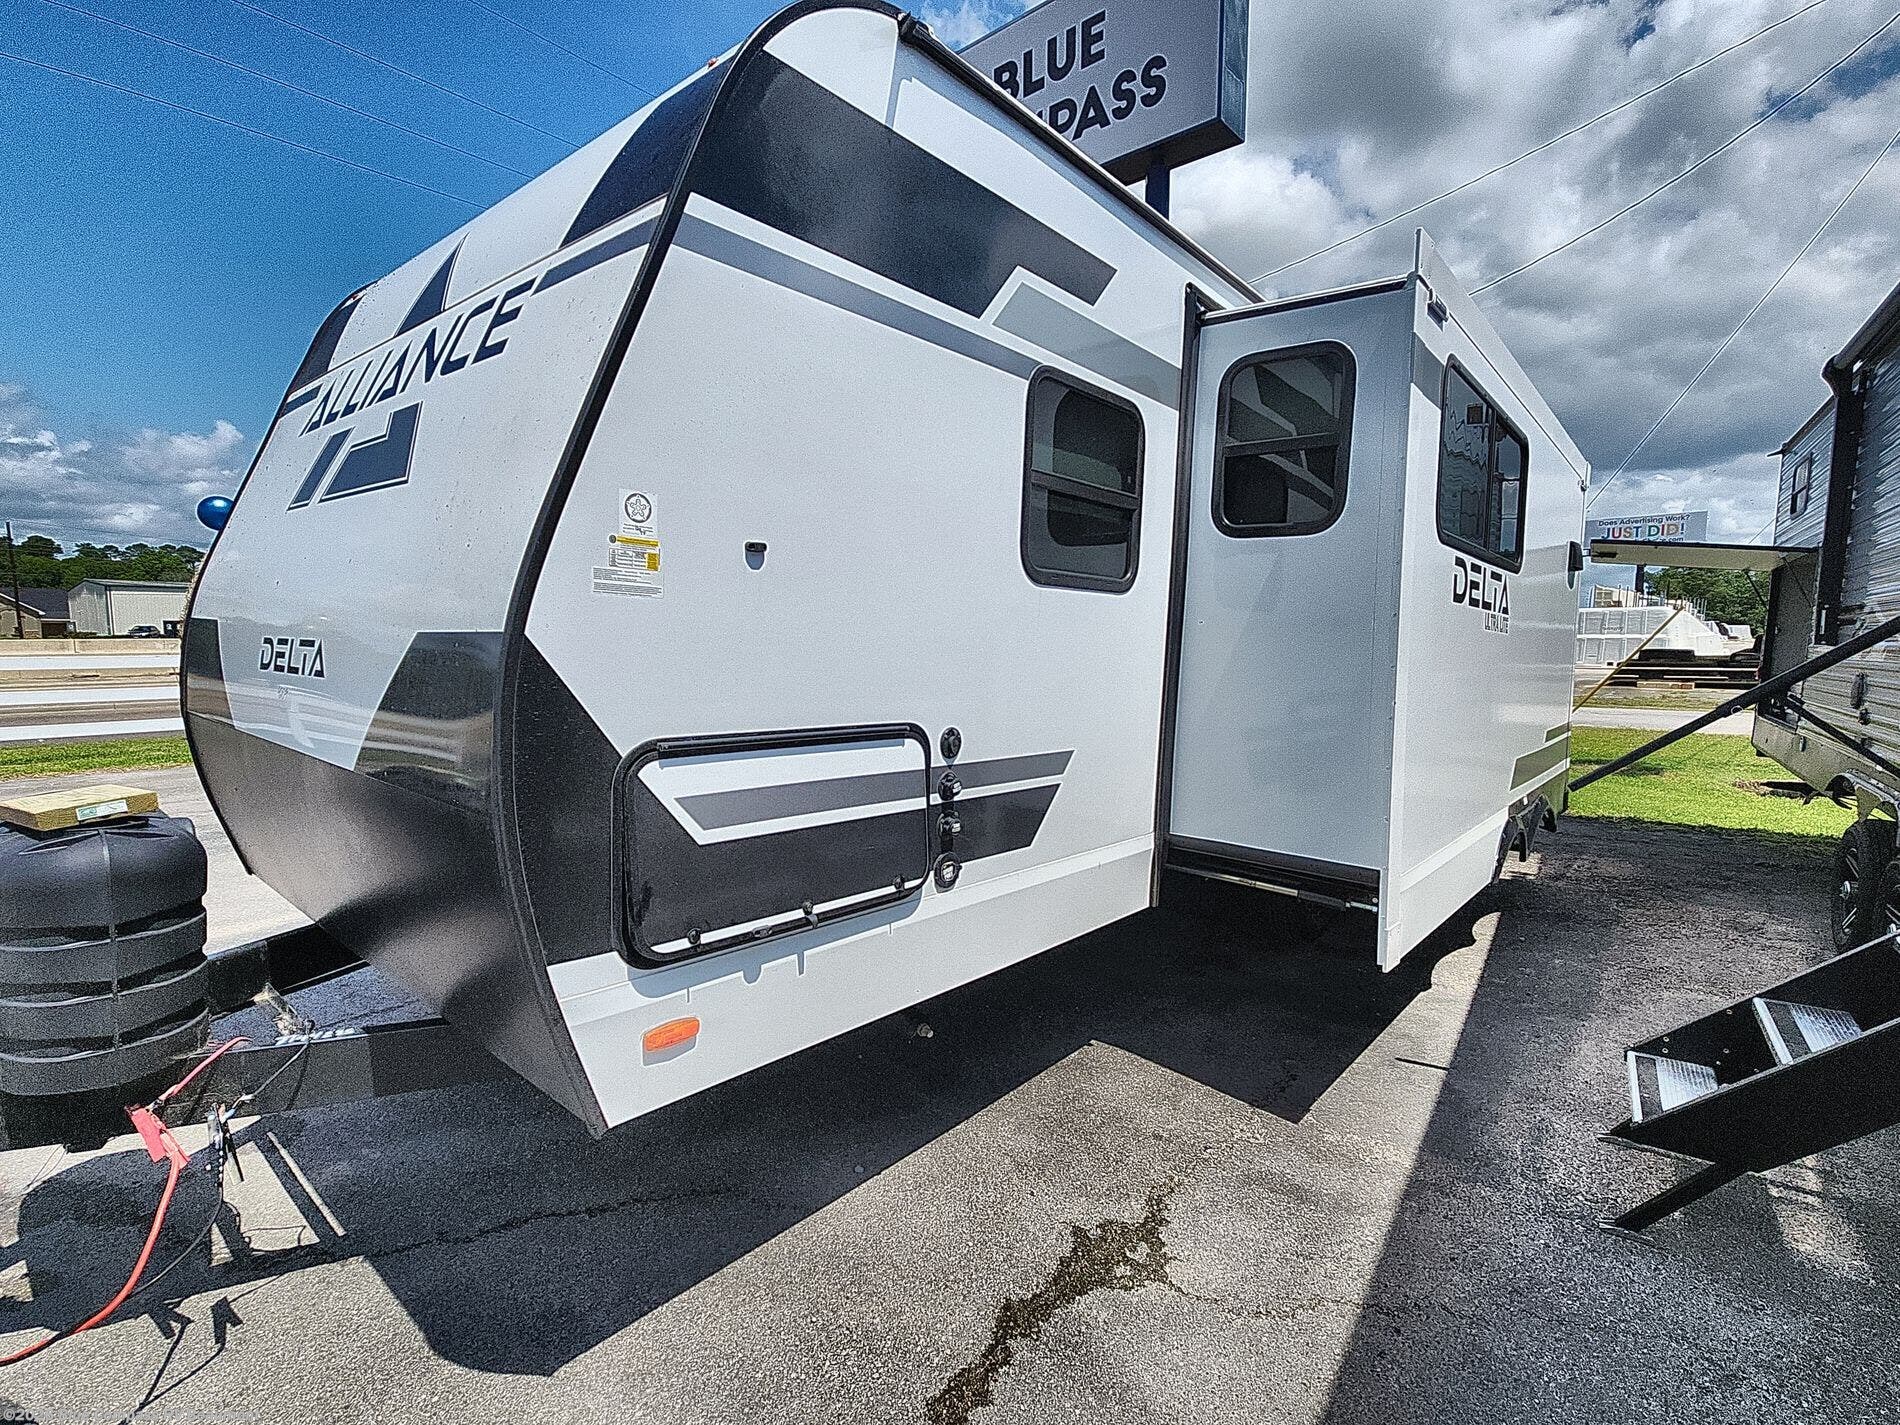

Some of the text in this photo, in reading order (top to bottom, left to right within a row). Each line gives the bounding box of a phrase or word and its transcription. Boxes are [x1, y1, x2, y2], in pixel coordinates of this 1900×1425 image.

[993, 9, 1107, 98] BLUE
[1036, 55, 1167, 141] PASS
[299, 276, 538, 437] ALLIANCE
[1601, 525, 1642, 540] JUST
[1647, 523, 1685, 537] DID!
[1620, 517, 1663, 525] Advertising
[1665, 513, 1690, 522] Work?
[1453, 555, 1509, 615] DELTA
[260, 637, 325, 678] DELTA
